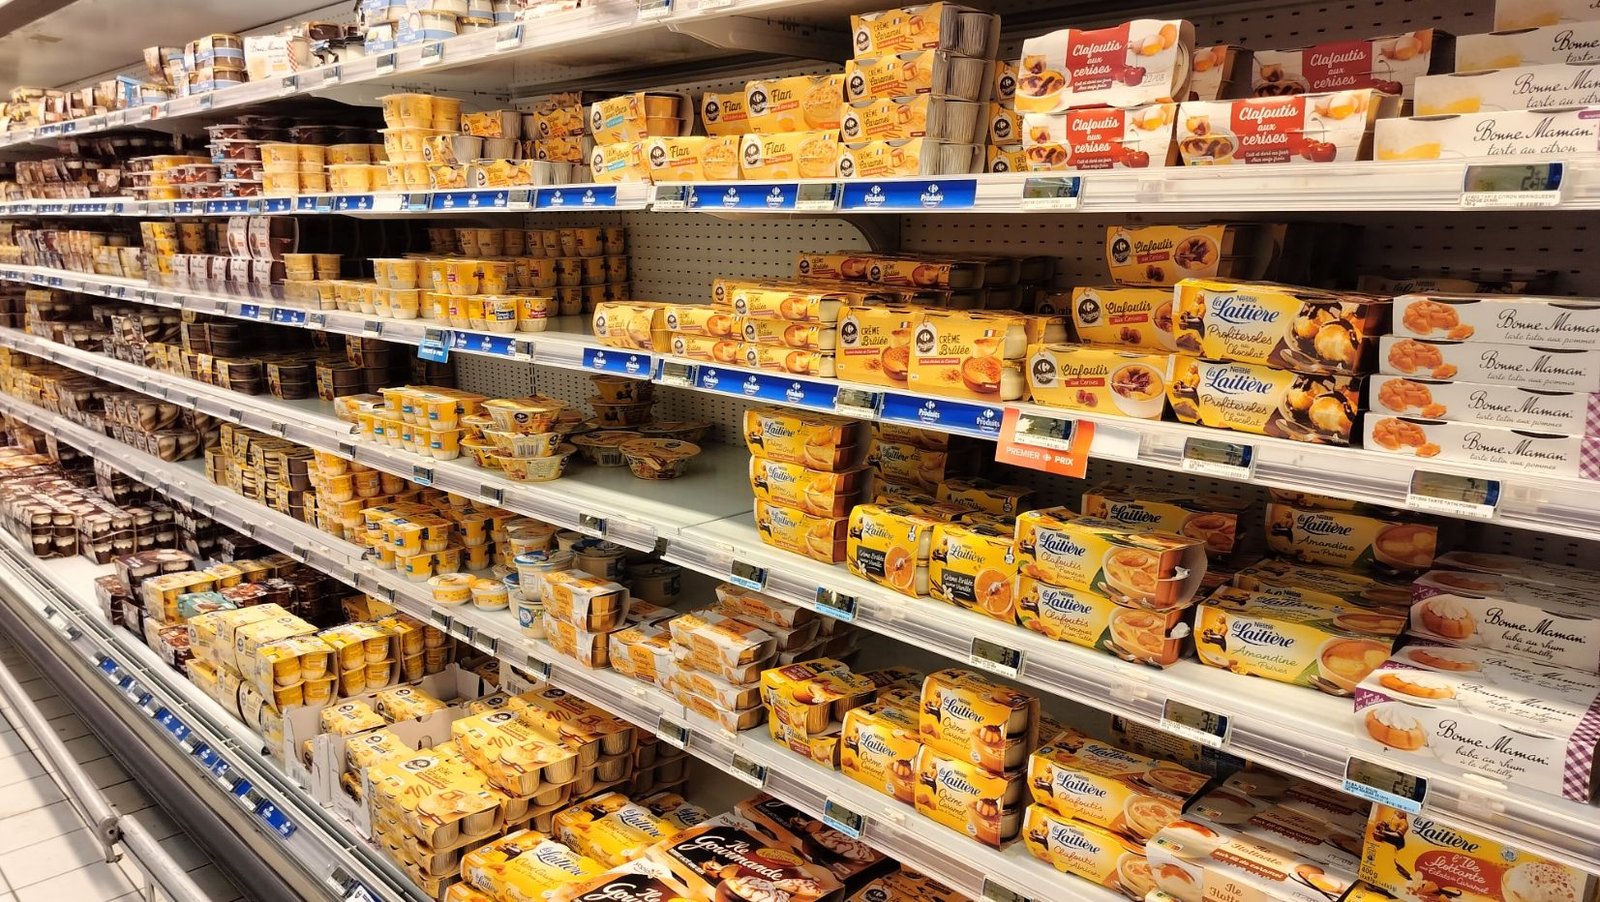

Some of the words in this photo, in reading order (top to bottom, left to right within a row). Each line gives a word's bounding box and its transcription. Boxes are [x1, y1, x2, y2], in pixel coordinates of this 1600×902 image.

[1552, 29, 1599, 51] Bonne
[1072, 40, 1122, 57] Clafoutis
[1087, 56, 1103, 64] aux
[1310, 49, 1367, 68] Clafoutis
[1073, 64, 1111, 77] cerises
[1328, 67, 1345, 75] aux
[1313, 75, 1357, 89] cerises
[771, 89, 792, 103] Flan
[1526, 95, 1554, 108] tarte
[722, 101, 742, 112] Flan
[1239, 103, 1298, 124] Clafoutis
[1072, 117, 1120, 133] Clafoutis
[1257, 123, 1276, 132] aux
[1474, 119, 1523, 142] Bonne
[1526, 116, 1593, 138] Maman
[1087, 133, 1102, 141] aux
[1243, 132, 1288, 146] cerises
[670, 146, 690, 159] Flan
[765, 143, 786, 155] Flan
[1075, 141, 1111, 153] cerises
[1487, 143, 1514, 155] tarte
[1540, 143, 1577, 154] citron
[864, 194, 885, 202] Produits
[920, 193, 943, 202] Produits
[1134, 239, 1173, 253] Clafoutis
[1106, 301, 1152, 314] Clafoutis
[1212, 296, 1222, 308] la
[1212, 298, 1280, 325] Laitière
[1497, 308, 1543, 330] Bonne
[861, 335, 888, 346] Brûlée
[939, 334, 961, 343] CRÈME
[1207, 324, 1273, 346] Profiteroles
[1504, 332, 1524, 341] tarte
[1526, 333, 1545, 341] tatin
[1562, 337, 1596, 345] pommes
[939, 343, 970, 355] Brûlée
[1226, 343, 1265, 359] Chocolat
[1061, 364, 1109, 378] Clafoutis
[1480, 350, 1525, 371] Bonne
[1526, 354, 1586, 377] Maman
[1206, 367, 1216, 378] la
[1487, 373, 1506, 381] tarte
[1508, 373, 1526, 382] tatin
[1543, 378, 1575, 387] pommes
[1205, 369, 1273, 395] Laitière
[1201, 394, 1267, 415] Profiteroles
[1468, 390, 1513, 412] Bonne
[1514, 396, 1573, 419] Maman
[918, 409, 940, 419] Produits
[977, 417, 1000, 427] Produits
[1224, 412, 1262, 427] Chocolat
[1476, 412, 1495, 422] tarte
[1496, 415, 1514, 423] tatin
[1531, 420, 1563, 428] pommes
[1462, 431, 1507, 452] Bonne
[1508, 439, 1567, 461] Maman
[1006, 447, 1040, 459] PREMIER
[1054, 455, 1074, 466] PRIX
[1470, 453, 1488, 462] tarte
[1489, 455, 1508, 464] tatin
[1524, 461, 1556, 470] pommes
[769, 467, 797, 483] Laitière
[865, 522, 895, 540] Laitière
[1039, 534, 1086, 558] Laitière
[1297, 536, 1355, 552] Amandine
[1040, 553, 1081, 571] Clafoutis
[1042, 592, 1092, 615] Laitière
[1044, 610, 1088, 627] Clafoutis
[1232, 621, 1241, 631] la
[1484, 608, 1527, 632] Bonne
[1528, 618, 1586, 644] Maman
[1232, 623, 1295, 648] Laitière
[1502, 631, 1523, 644] baba
[1541, 639, 1565, 652] rhum
[1231, 645, 1298, 666] Amandine
[1458, 681, 1503, 699] Bonne
[943, 699, 984, 724] Laitière
[942, 716, 967, 734] Crème
[942, 727, 970, 743] Caramel
[1436, 719, 1484, 748] Bonne
[1486, 735, 1549, 766] Maman
[860, 734, 896, 758] Laitière
[860, 751, 882, 768] Crème
[1455, 746, 1480, 760] baba
[1482, 757, 1497, 765] au
[1499, 756, 1526, 773] rhum
[860, 761, 885, 777] Caramel
[938, 769, 981, 796] Laitière
[1057, 774, 1107, 798] Laitière
[938, 788, 963, 807] Crème
[1059, 792, 1103, 812] Clafoutis
[938, 799, 967, 816] Caramel
[1077, 807, 1107, 822] Abricots
[1413, 817, 1423, 827] la
[1052, 827, 1101, 855] Laitière
[1412, 820, 1480, 853] Laitière
[725, 840, 750, 855] Ile
[678, 836, 783, 881] Gourmande
[1053, 846, 1097, 866] Clafoutis
[1072, 862, 1101, 879] Abricots
[1225, 883, 1243, 896] Ile
